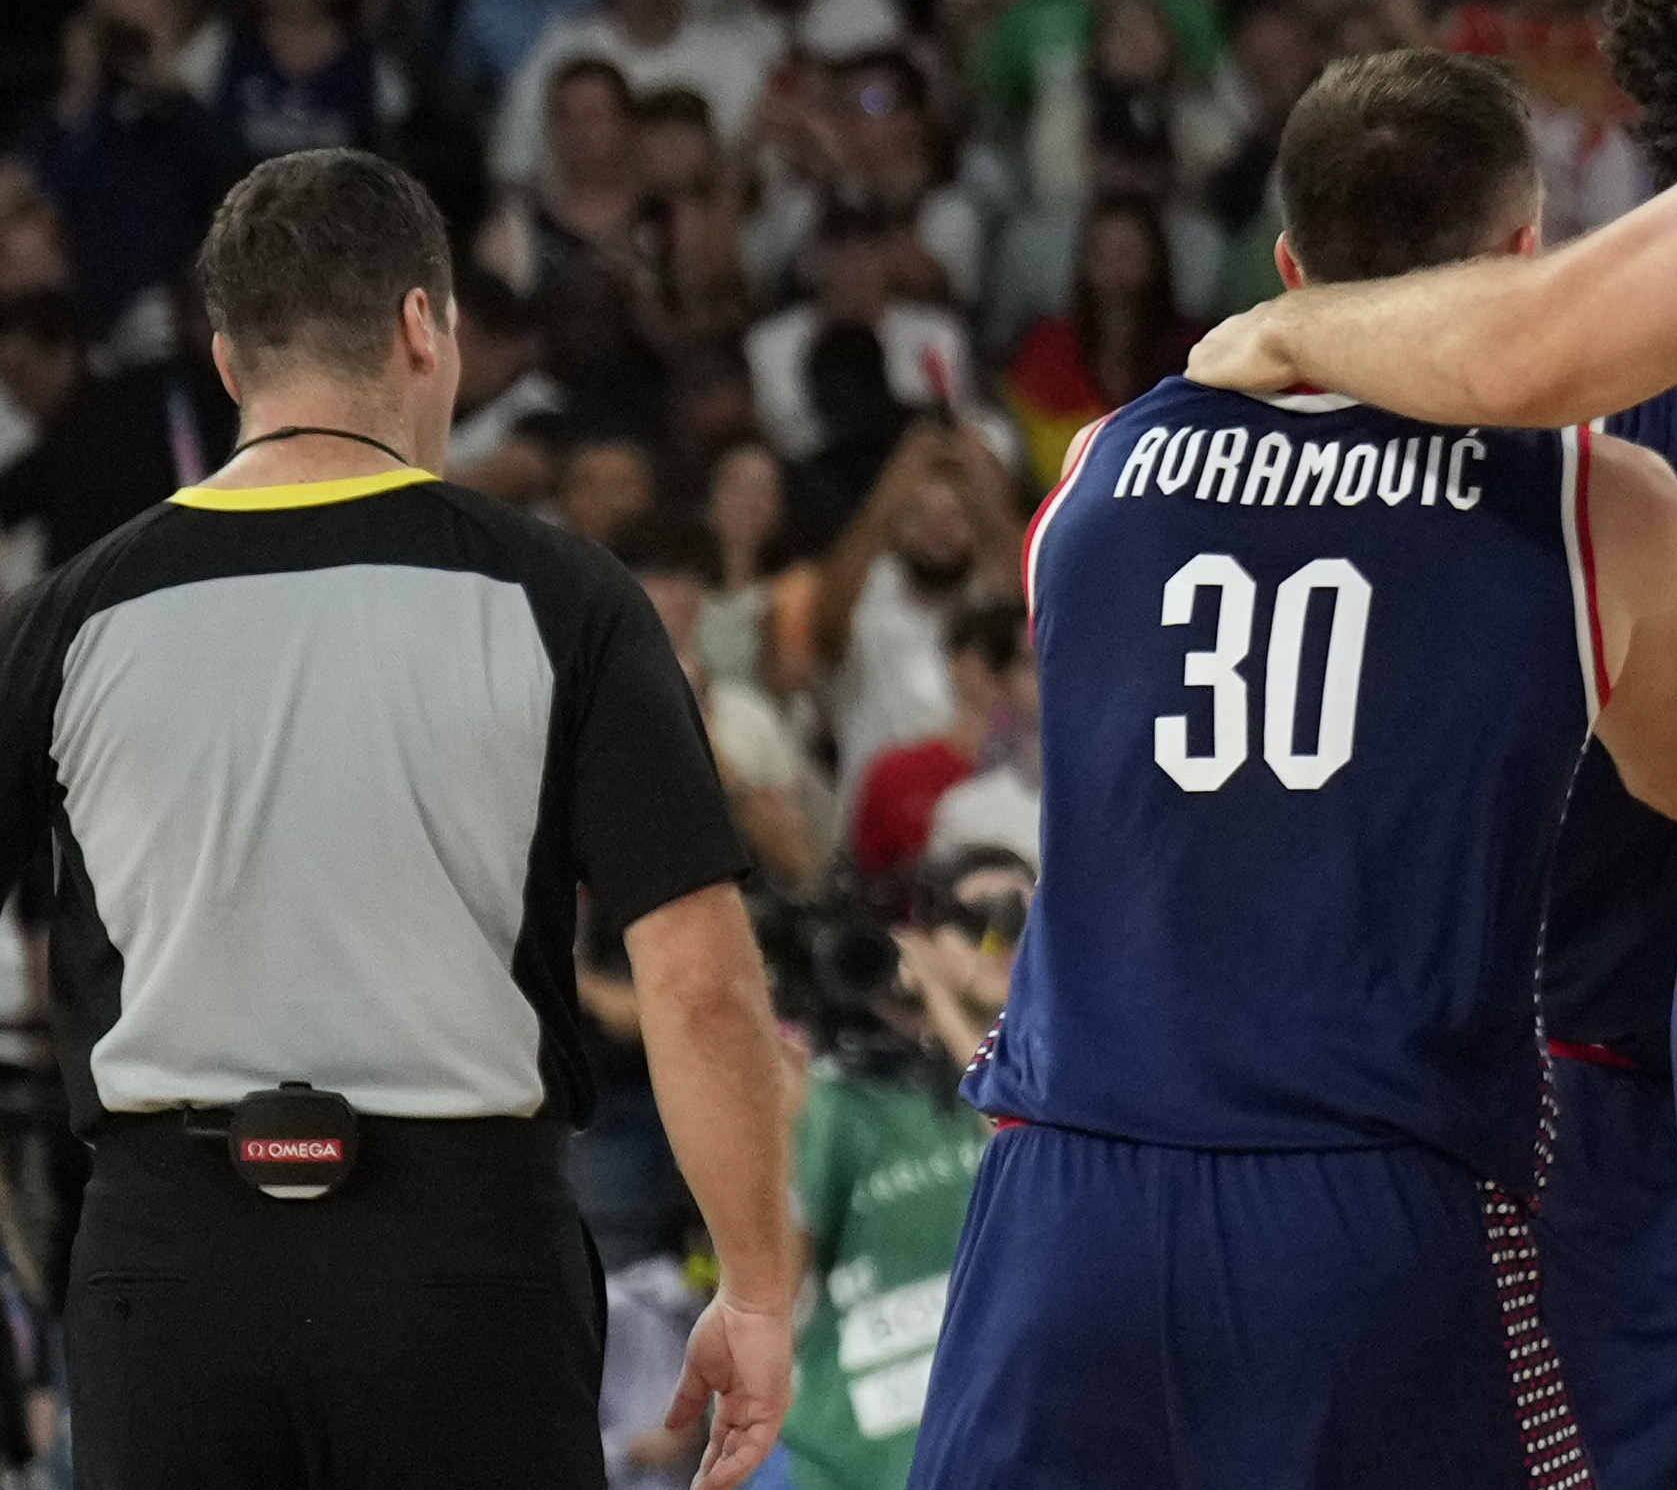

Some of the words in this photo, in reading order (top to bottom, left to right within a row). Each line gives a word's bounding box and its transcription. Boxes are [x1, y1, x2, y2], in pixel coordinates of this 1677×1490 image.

[1112, 425, 1488, 511] AVRAMOVIĆ
[1154, 553, 1373, 793] 30
[268, 1142, 339, 1159] OMEGA
